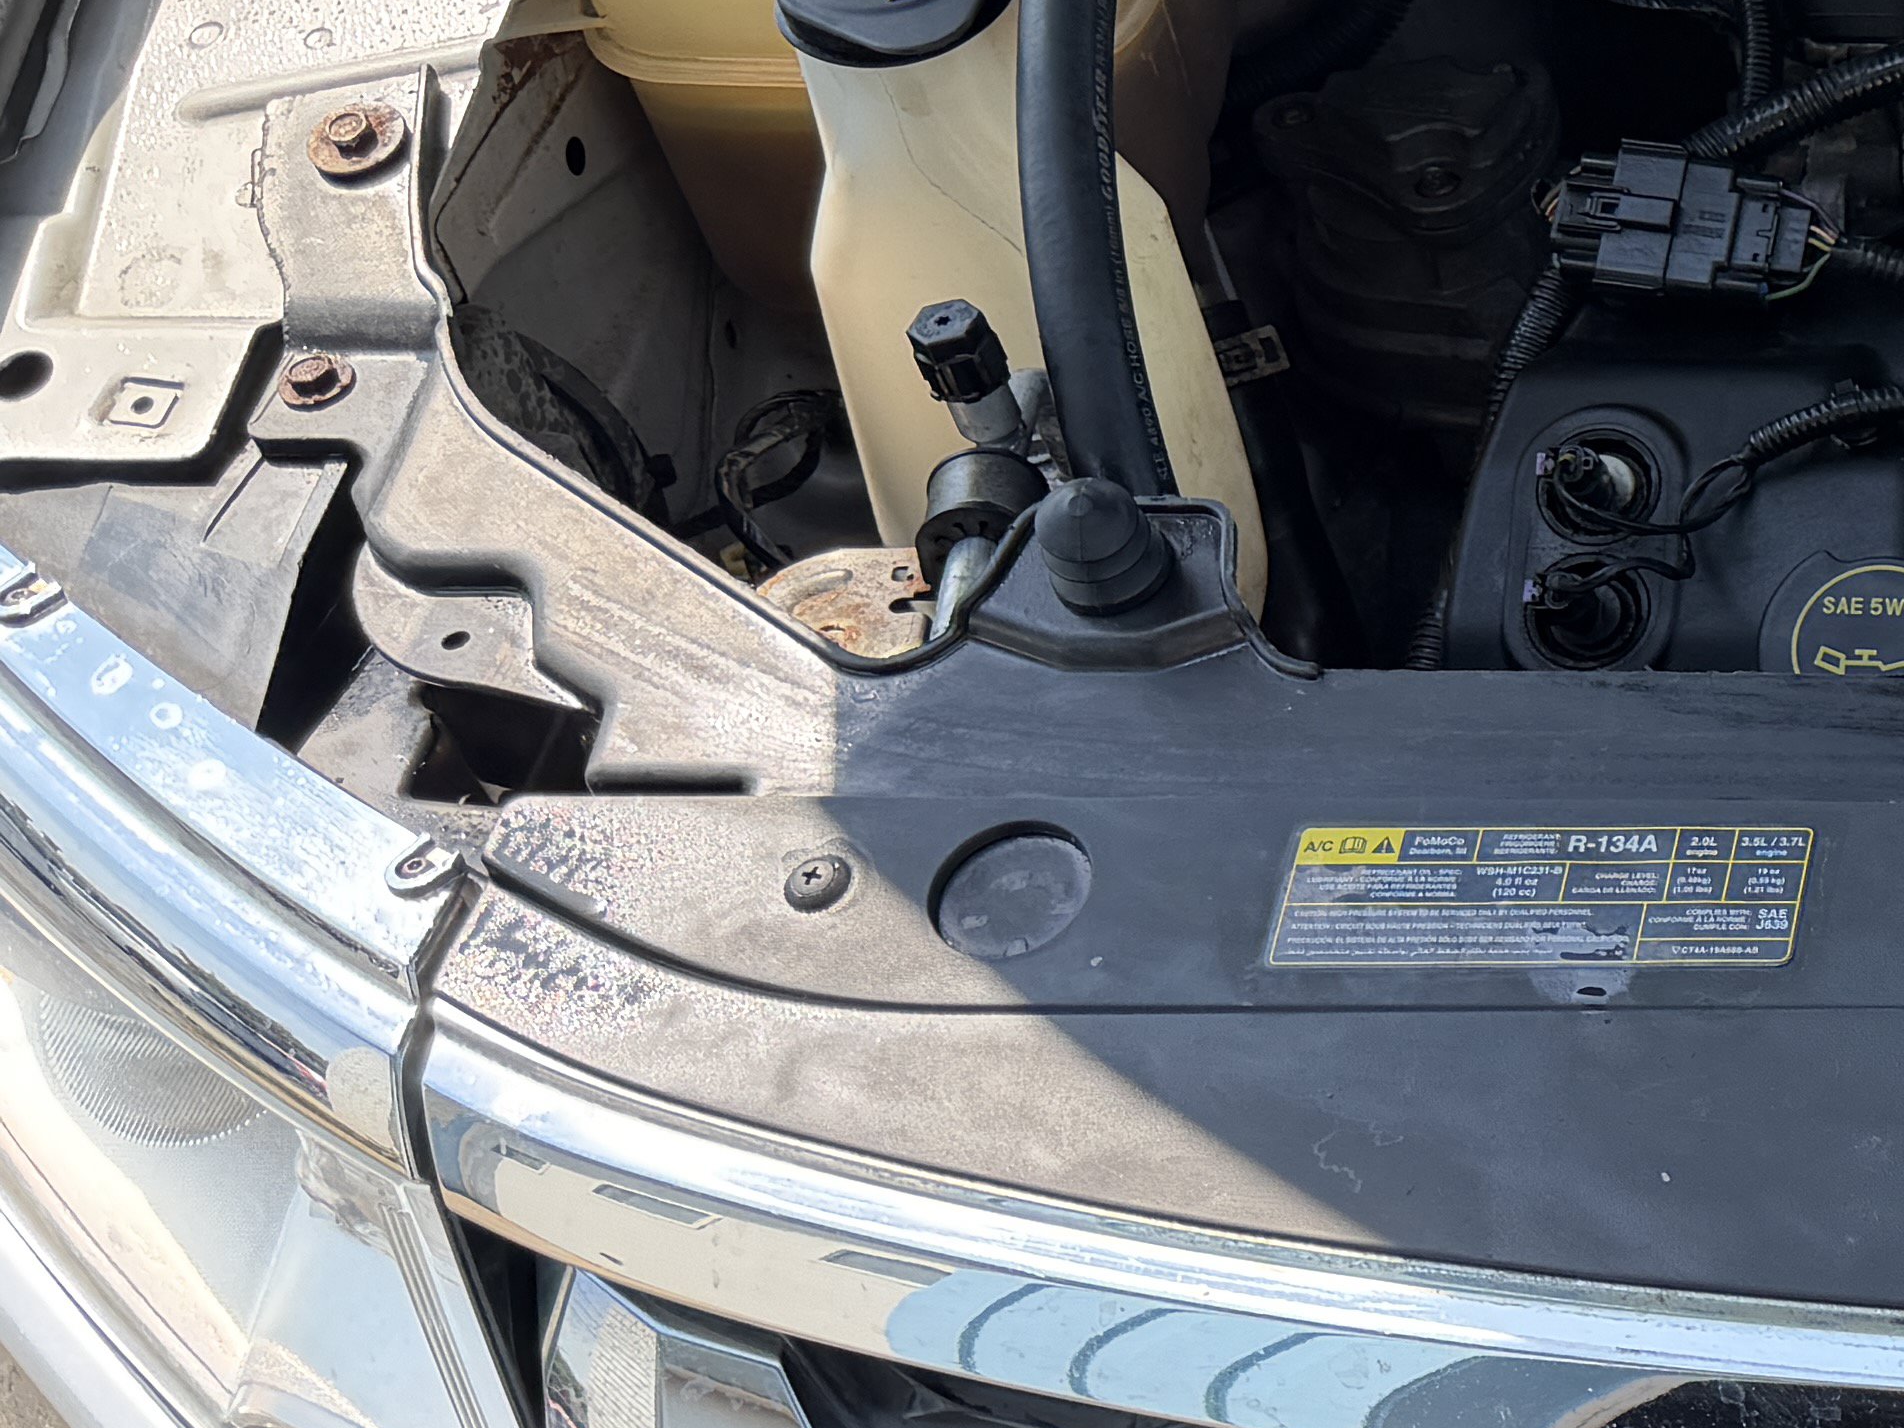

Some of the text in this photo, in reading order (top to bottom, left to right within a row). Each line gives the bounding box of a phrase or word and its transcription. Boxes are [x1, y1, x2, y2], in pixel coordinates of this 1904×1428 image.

[1092, 68, 1115, 201] GOODYEAR
[1823, 596, 1865, 615] SAE
[1304, 840, 1334, 853] A/C
[1414, 836, 1466, 847] FoMoCo
[1567, 834, 1659, 854] R-134A
[1689, 837, 1718, 847] 2.0L
[1778, 837, 1807, 847] 3.7L
[1755, 848, 1788, 857] engine
[1757, 908, 1788, 919] SAE
